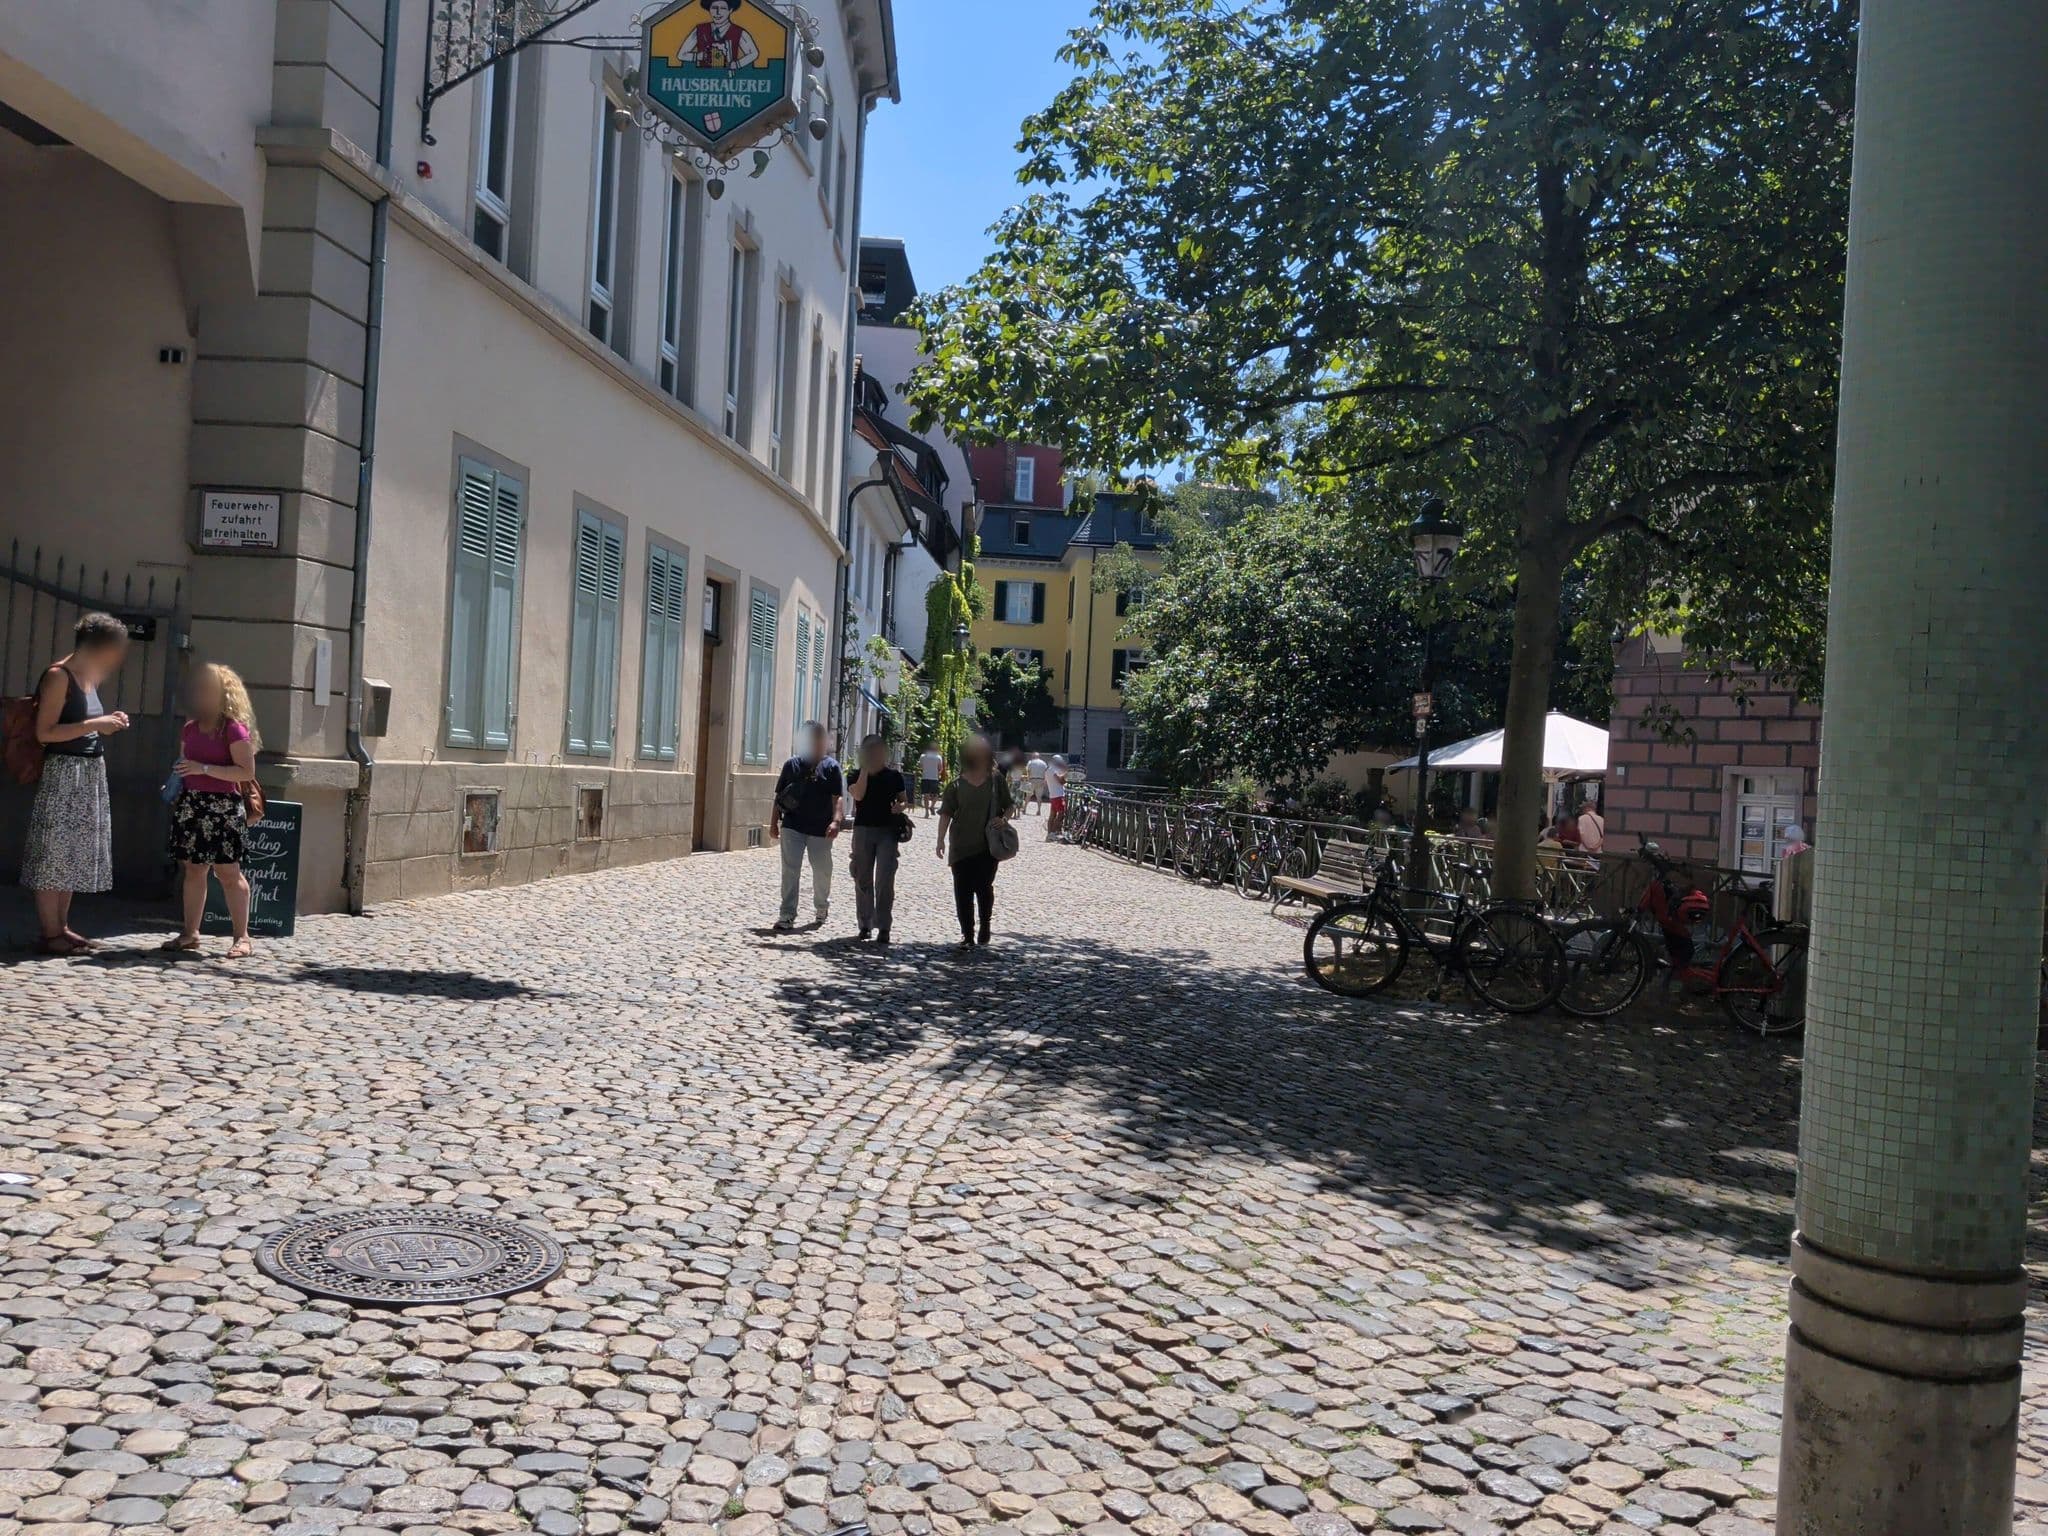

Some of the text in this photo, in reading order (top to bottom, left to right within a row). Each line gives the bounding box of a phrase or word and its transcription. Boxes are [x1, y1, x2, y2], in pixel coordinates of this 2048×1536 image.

[661, 78, 771, 93] HAUSBRAUEREI
[677, 93, 752, 108] FEIERLING
[211, 499, 274, 511] Feuerwehr-
[221, 515, 262, 525] zufahrt
[214, 528, 267, 540] freihalten
[255, 816, 296, 832] brauerei
[250, 884, 281, 913] ffnet
